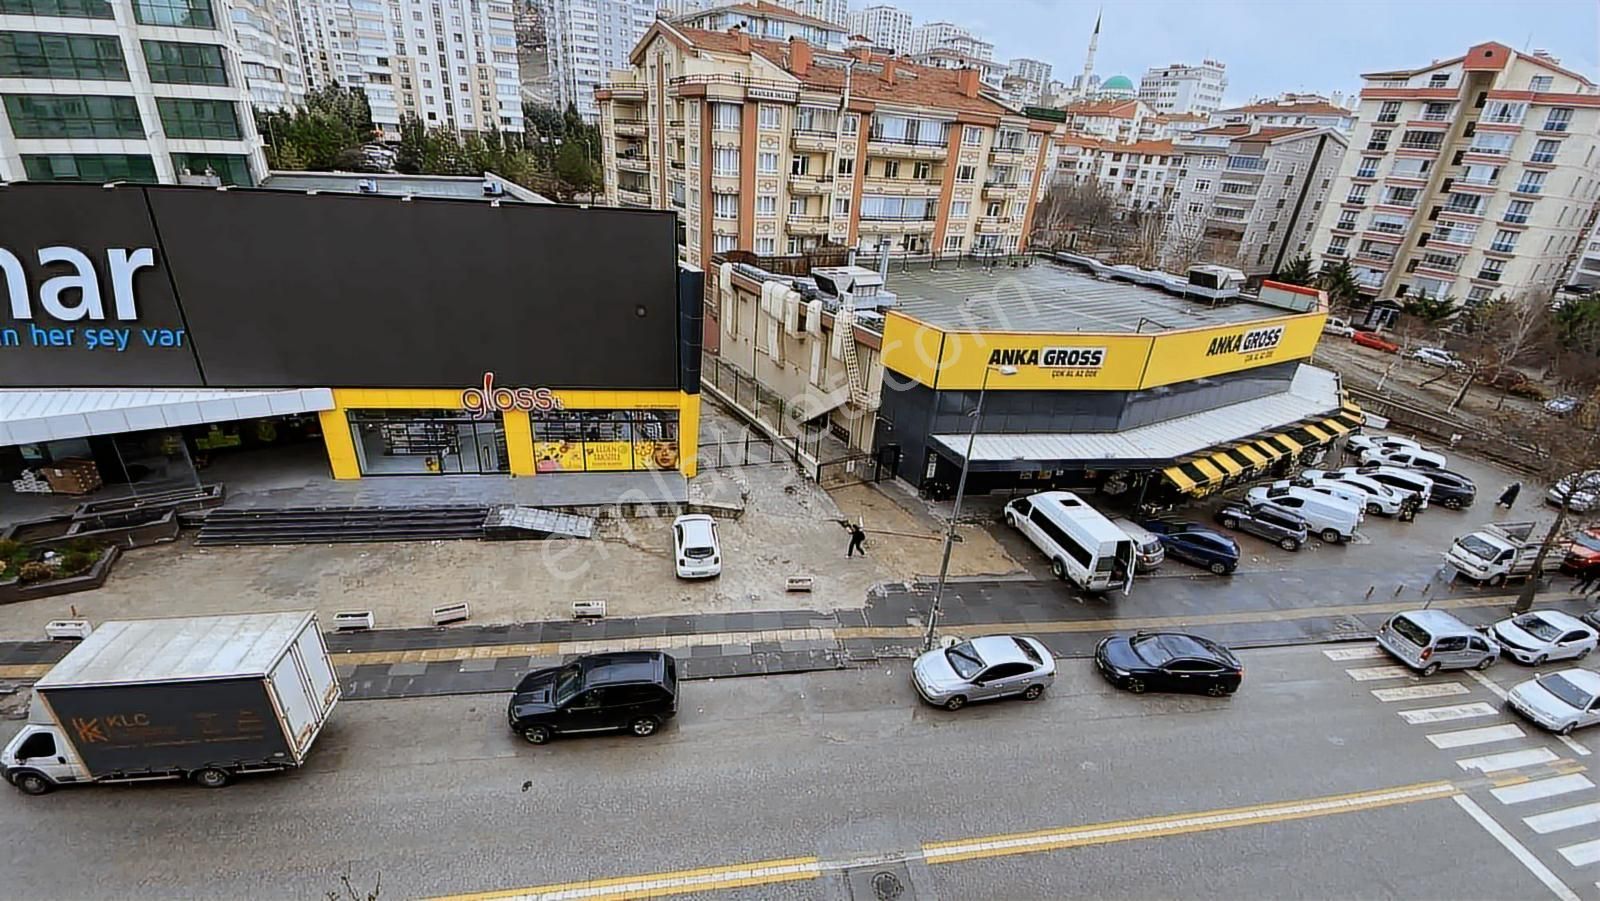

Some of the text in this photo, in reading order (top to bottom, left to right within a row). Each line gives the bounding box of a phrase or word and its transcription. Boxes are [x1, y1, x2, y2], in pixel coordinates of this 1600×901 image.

[30, 324, 74, 346] her
[84, 329, 130, 351] şey
[142, 329, 185, 346] var
[1206, 328, 1282, 356] ANKA GROSS
[988, 349, 1103, 366] ANKA GROSS
[461, 372, 554, 420] gloss
[106, 713, 150, 727] KLC
